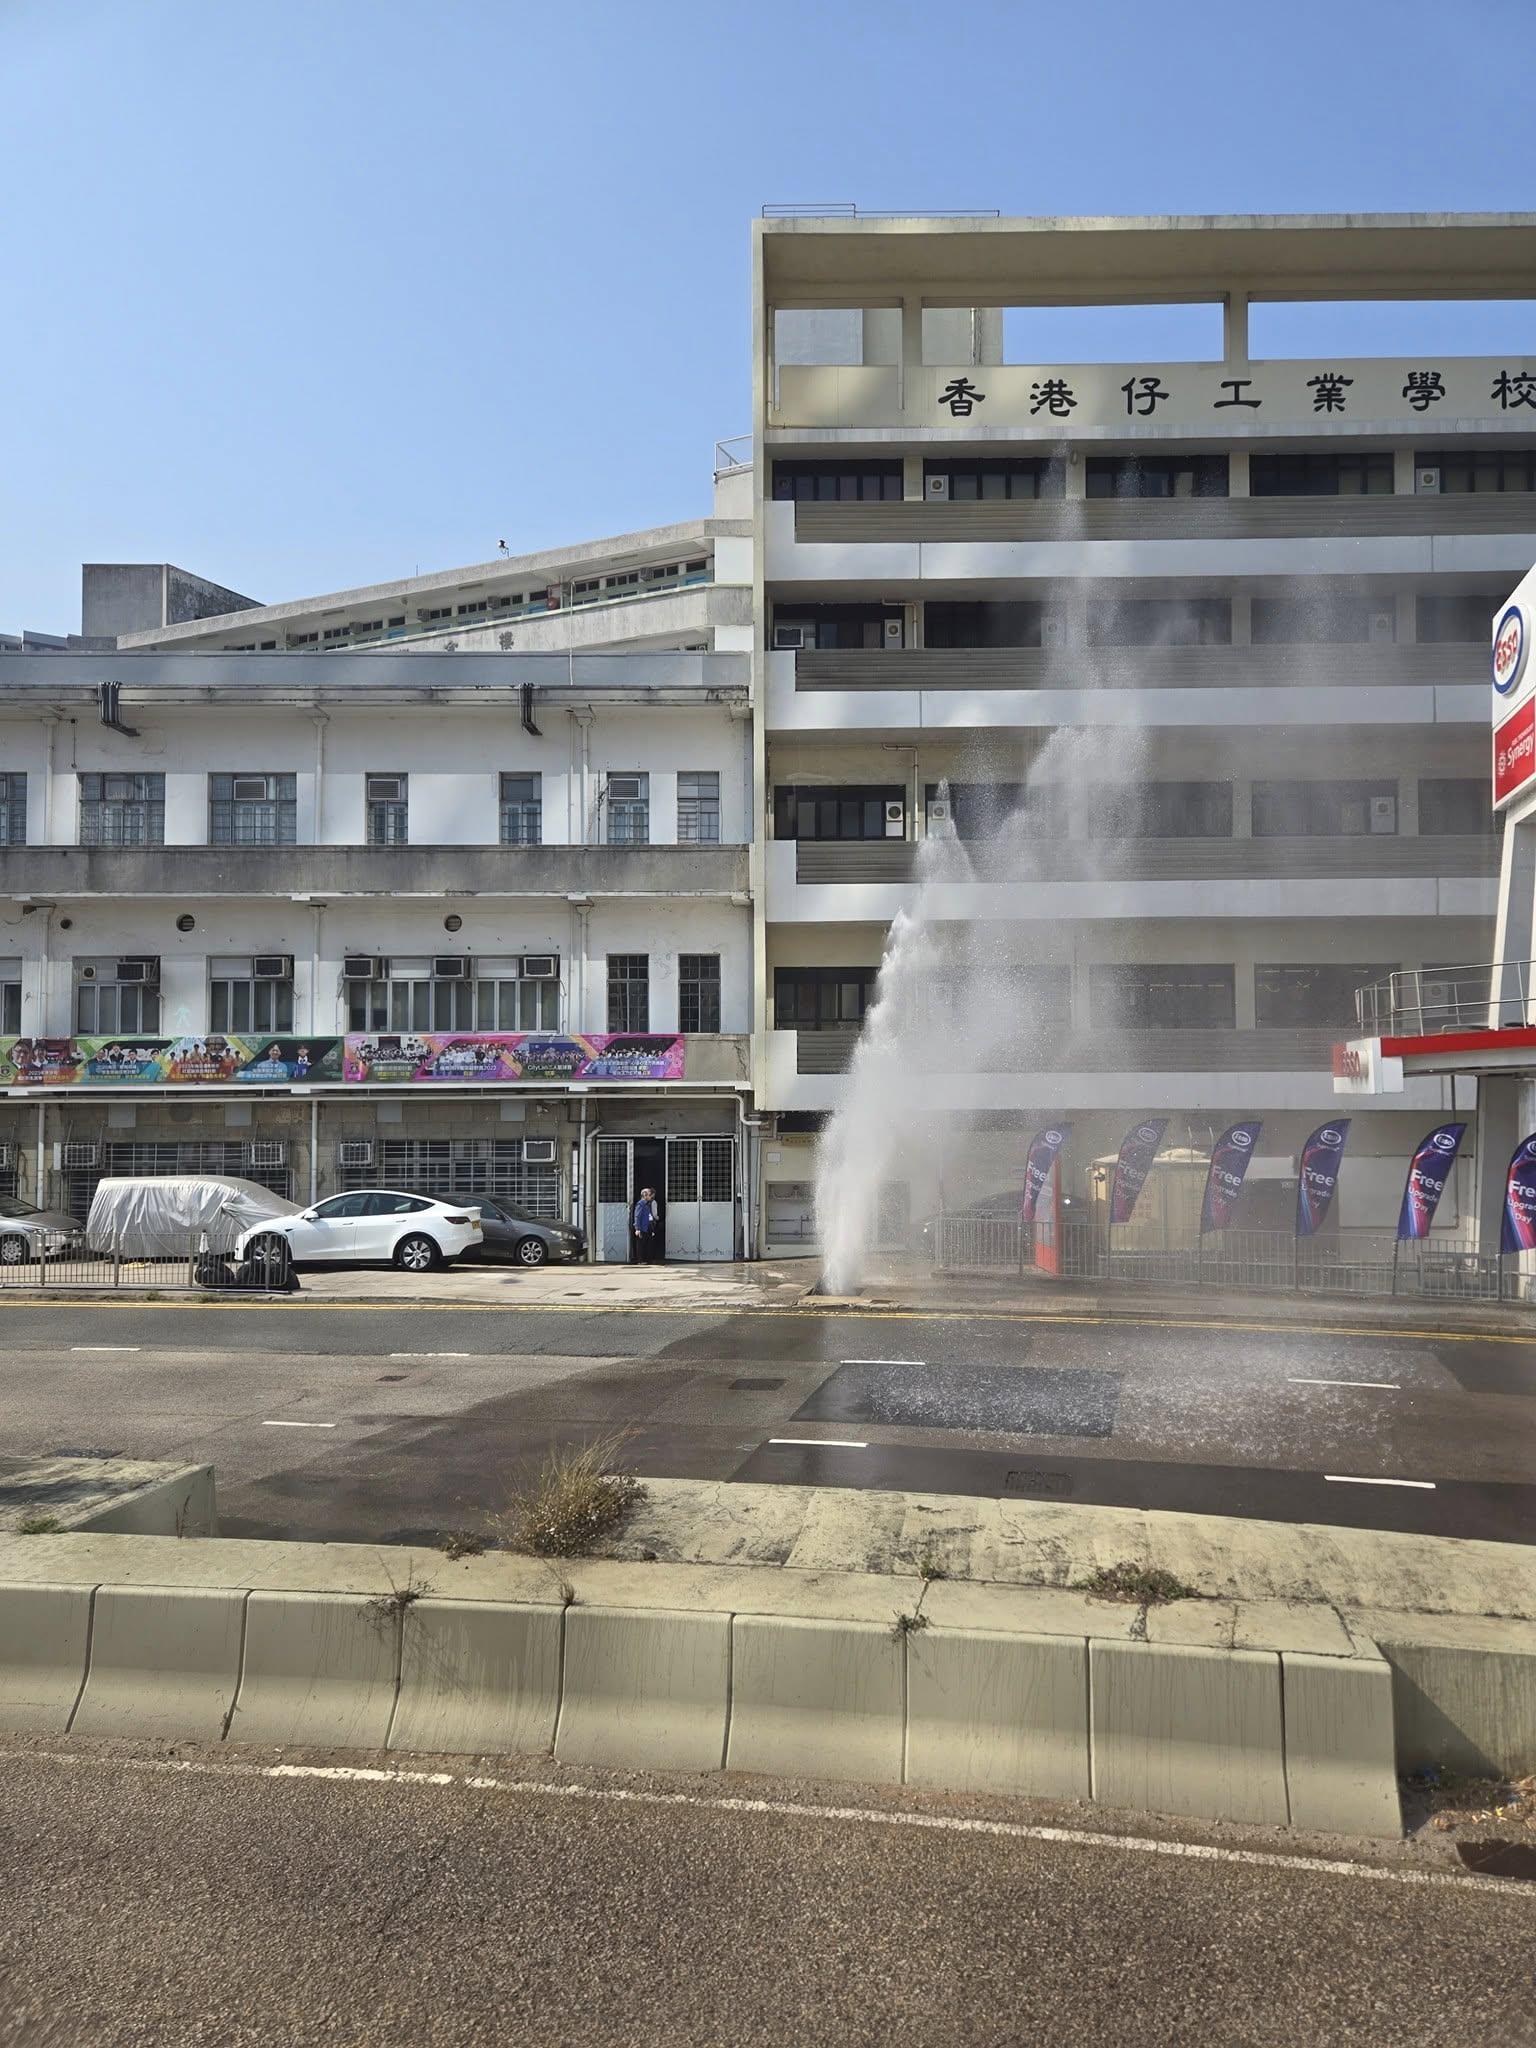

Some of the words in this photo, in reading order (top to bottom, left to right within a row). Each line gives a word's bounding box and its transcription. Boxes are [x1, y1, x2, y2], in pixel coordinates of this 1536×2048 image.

[938, 370, 1536, 417] 香港仔工業學校
[1507, 731, 1534, 769] Synergy
[1026, 1160, 1047, 1182] Free
[1118, 1160, 1145, 1181] Free
[1211, 1165, 1242, 1187] Free
[1302, 1166, 1335, 1187] Free
[1409, 1168, 1443, 1191] Free
[1407, 1183, 1438, 1203] Upgrade
[1413, 1201, 1429, 1213] Day
[1514, 1212, 1533, 1225] Day
